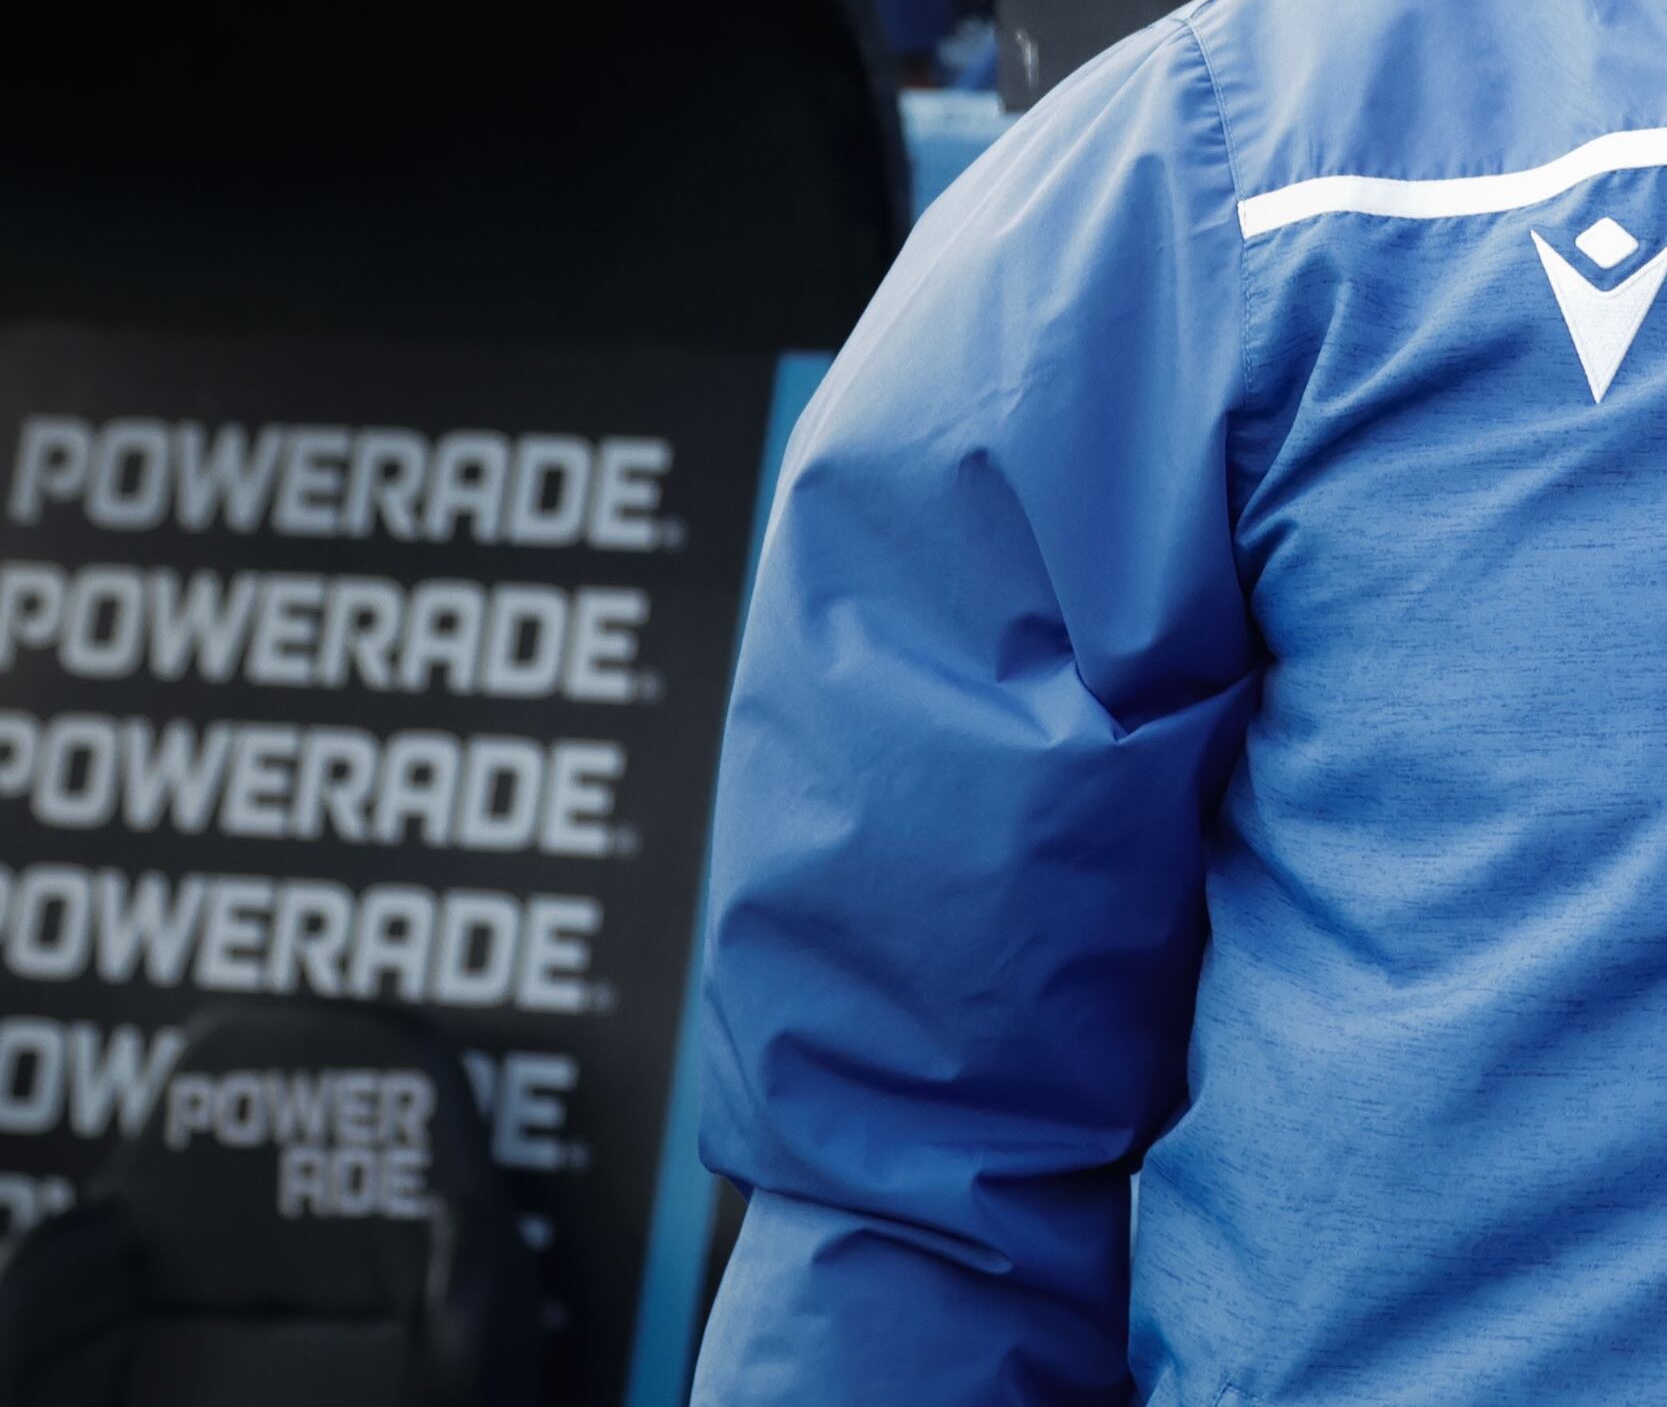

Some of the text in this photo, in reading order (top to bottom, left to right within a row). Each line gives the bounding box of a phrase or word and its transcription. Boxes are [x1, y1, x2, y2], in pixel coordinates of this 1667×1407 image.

[12, 414, 672, 550] POWERADE
[0, 862, 602, 1012] OWERADE
[164, 1068, 436, 1152] POWER
[277, 1147, 434, 1220] ADE
